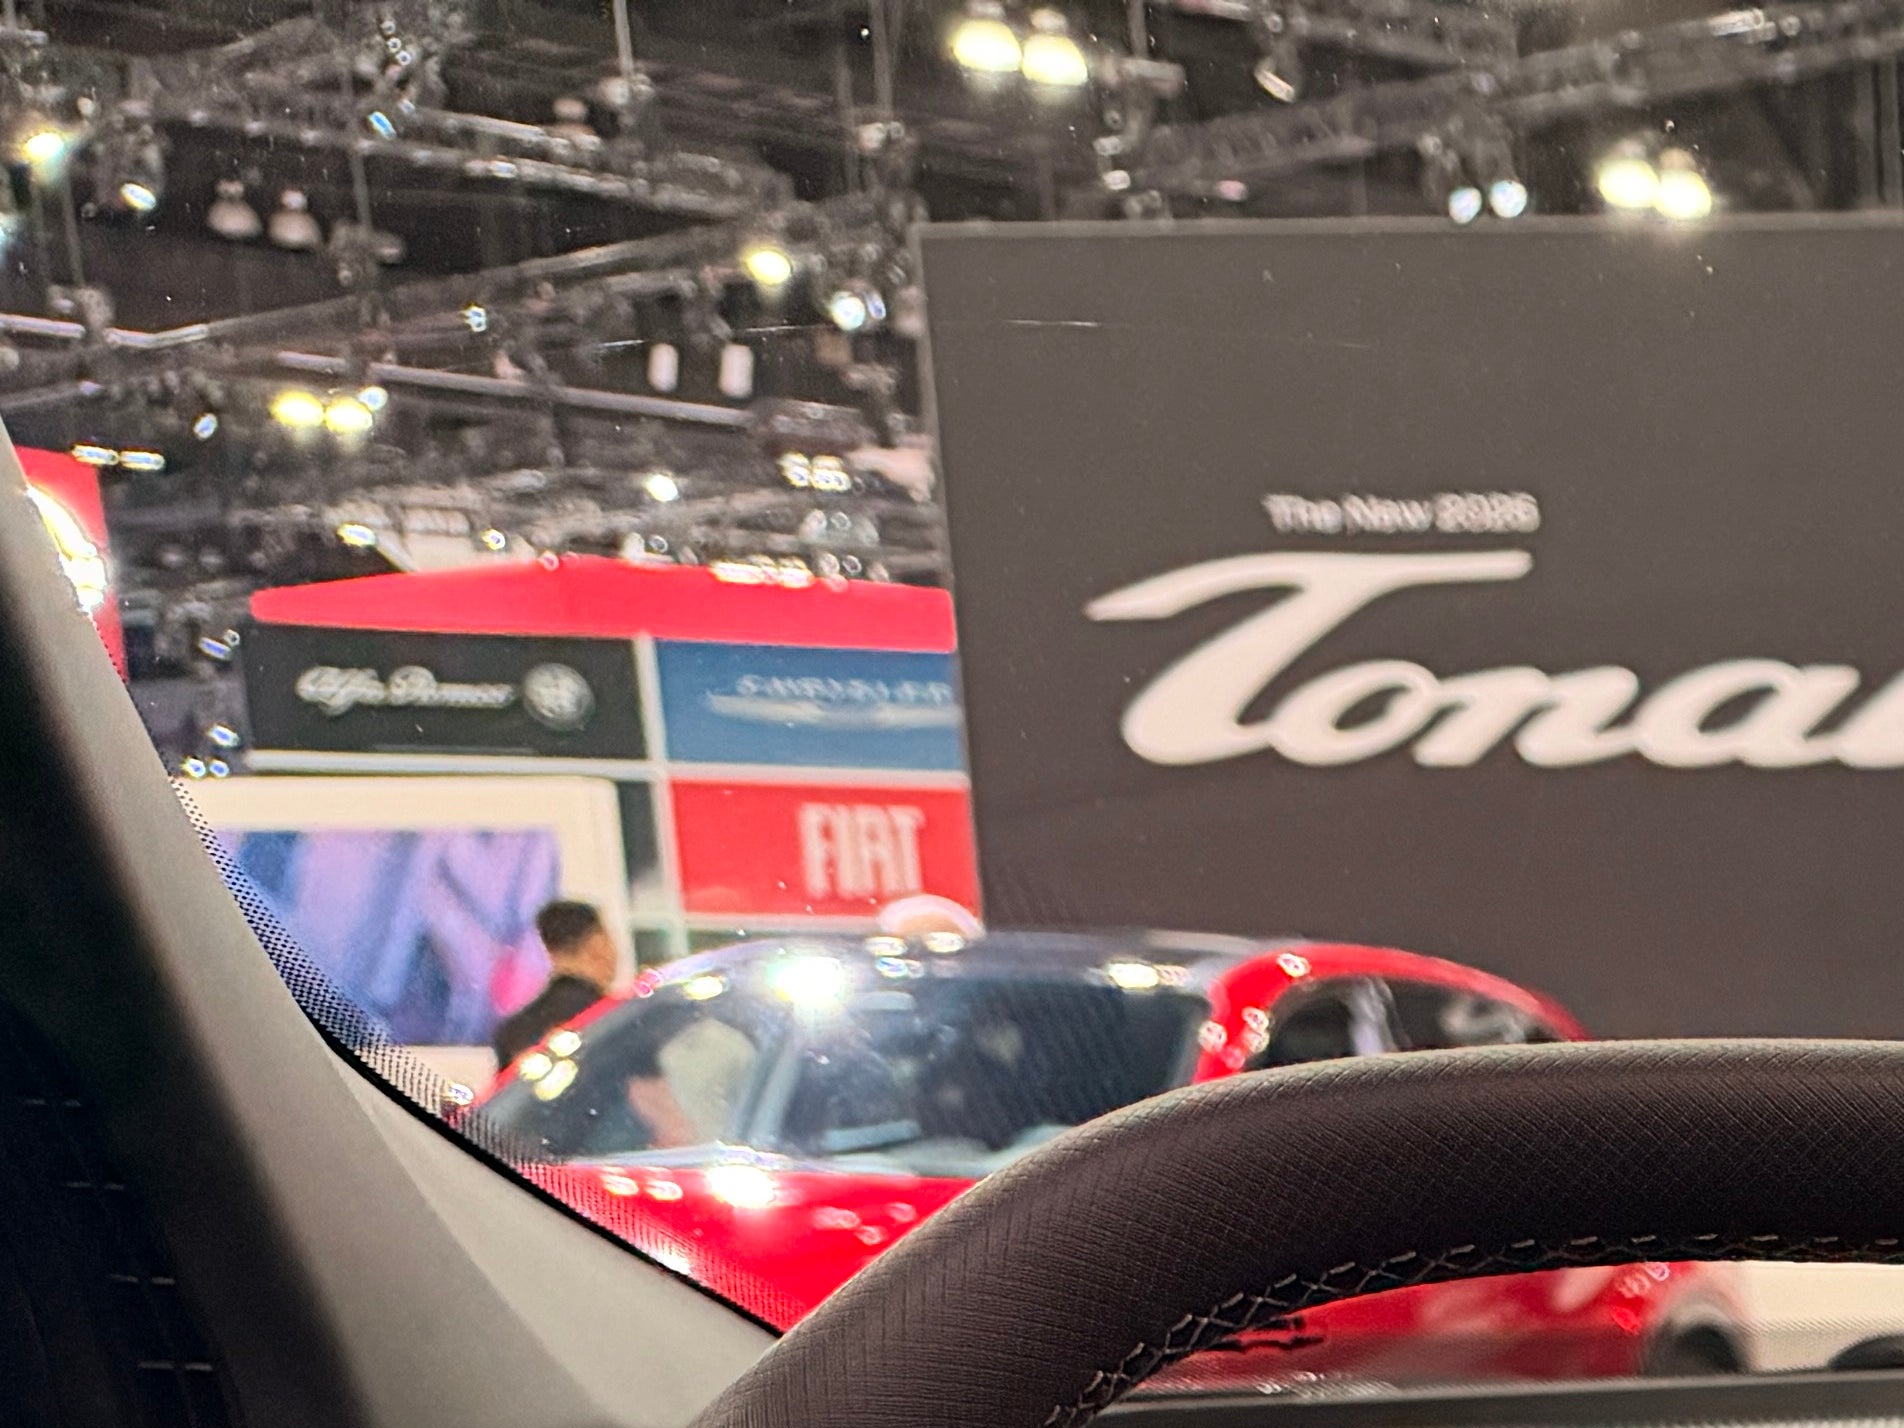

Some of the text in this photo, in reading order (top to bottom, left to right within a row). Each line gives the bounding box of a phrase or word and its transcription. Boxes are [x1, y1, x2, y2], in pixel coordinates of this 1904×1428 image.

[1261, 491, 1540, 534] The New 2026
[799, 802, 925, 899] FIAT
